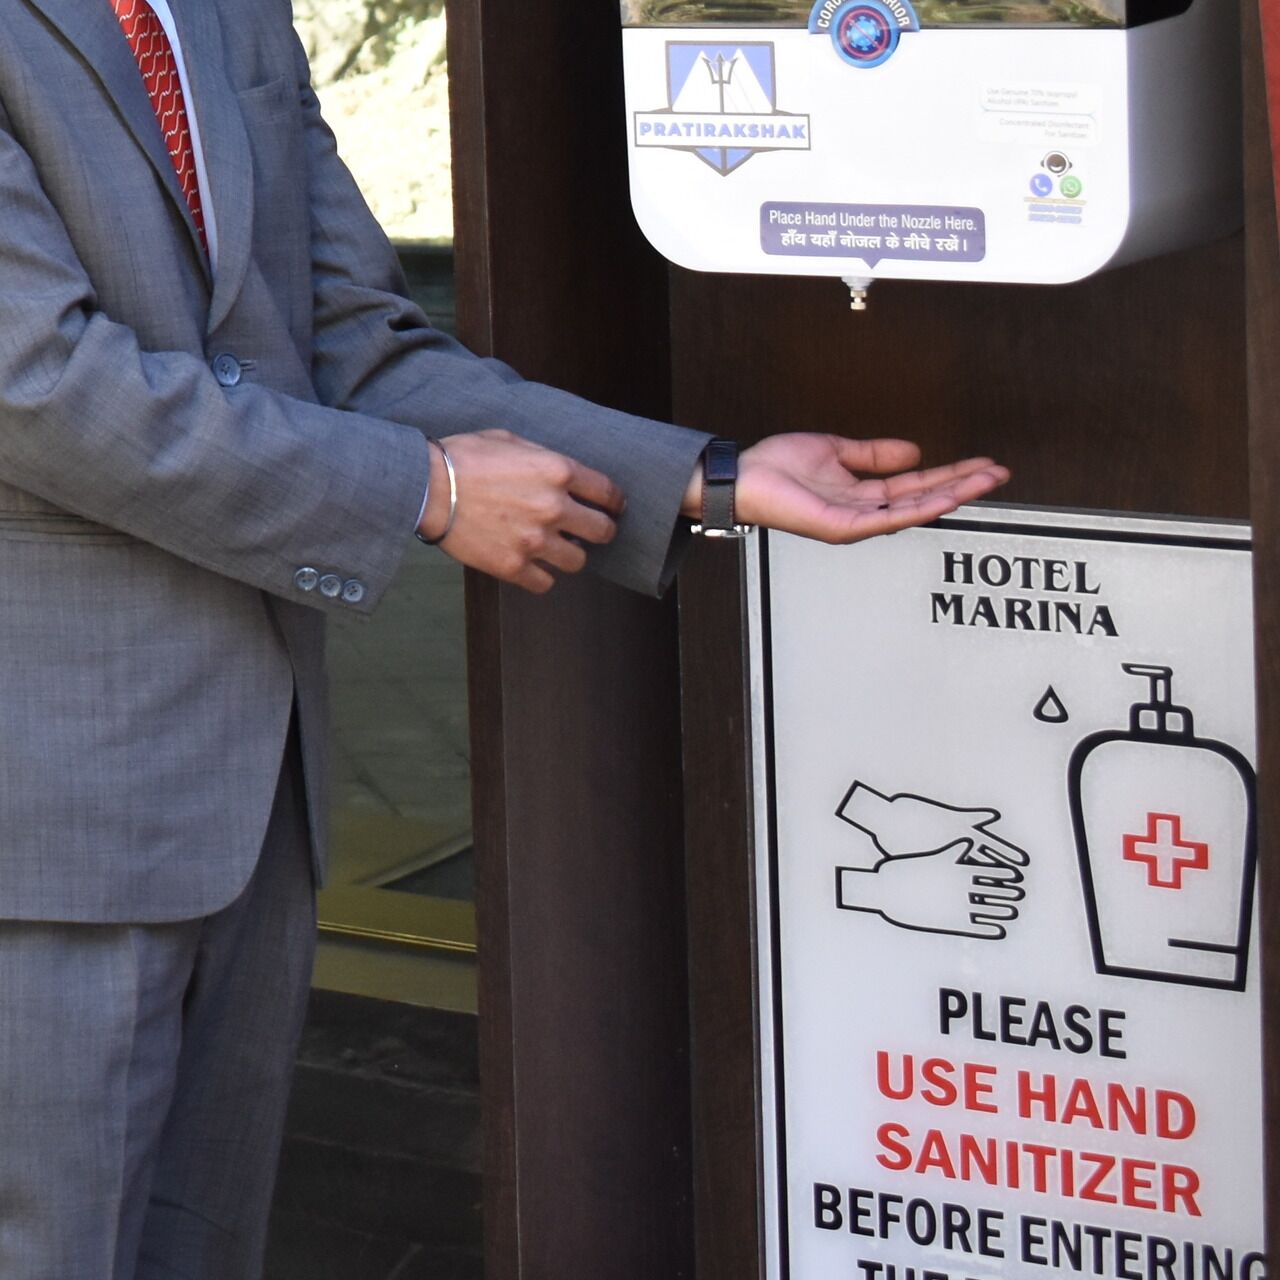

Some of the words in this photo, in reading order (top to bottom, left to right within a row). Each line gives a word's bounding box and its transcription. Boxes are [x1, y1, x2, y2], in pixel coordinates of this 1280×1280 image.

[639, 122, 806, 139] PRATIRAKSHAK
[769, 210, 802, 224] Place
[805, 211, 836, 226] Hand
[839, 212, 875, 227] Under
[879, 214, 898, 228] the
[901, 214, 941, 230] Nozzle
[945, 216, 977, 231] Here.
[885, 233, 900, 249] के
[942, 551, 1101, 595] HOTEL
[930, 592, 1119, 637] MARINA
[939, 987, 1127, 1060] PLEASE
[876, 1051, 999, 1114] USE
[1018, 1070, 1196, 1140] HAND
[876, 1121, 1203, 1217] SANITIZER
[813, 1180, 1005, 1259] BEFORE
